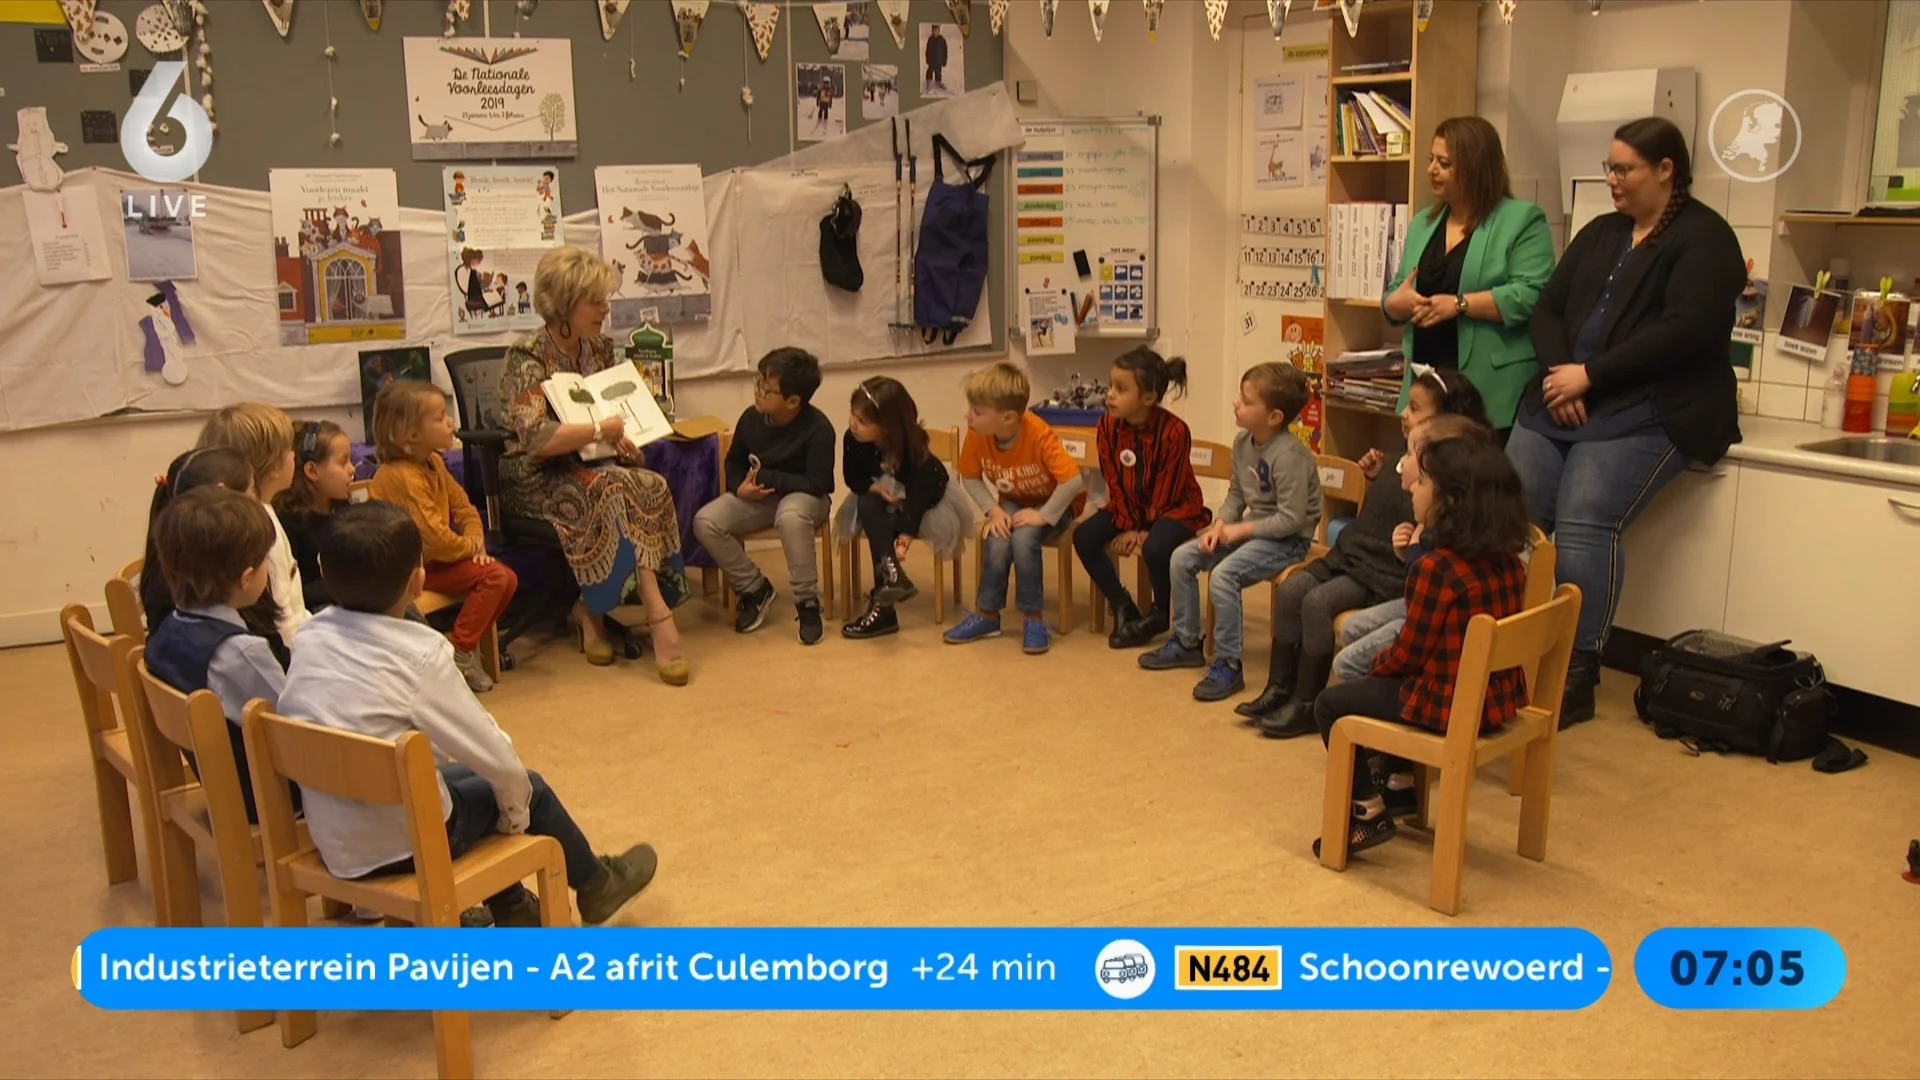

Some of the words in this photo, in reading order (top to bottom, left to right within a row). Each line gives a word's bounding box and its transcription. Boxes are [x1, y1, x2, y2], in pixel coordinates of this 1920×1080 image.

[453, 67, 468, 80] De
[472, 67, 530, 81] Nationale
[447, 82, 535, 100] Voorleesdagen
[481, 97, 505, 109] 2019
[300, 185, 341, 194] Voorlezen
[343, 185, 369, 193] maakt
[602, 186, 615, 194] Het
[617, 185, 649, 194] Nationale
[1246, 220, 1250, 230] 1
[1258, 220, 1263, 232] 2
[1271, 221, 1276, 232] 3
[1283, 222, 1289, 233] 4
[1297, 223, 1302, 235] 5
[1310, 222, 1316, 233] 6
[1030, 254, 1052, 262] zondag
[1244, 252, 1251, 262] 11
[1256, 252, 1264, 263] 12
[1268, 252, 1277, 263] 13
[1281, 252, 1290, 264] 14
[1294, 253, 1303, 264] 15
[1307, 252, 1316, 263] 16
[1244, 285, 1252, 296] 21
[1255, 285, 1265, 296] 22
[1268, 285, 1277, 297] 23
[1280, 286, 1290, 297] 24
[1294, 287, 1304, 298] 25
[1306, 286, 1317, 297] 26
[1243, 316, 1253, 329] 31
[1744, 332, 1760, 342] kring
[1784, 340, 1799, 350] boek
[1800, 346, 1818, 355] lezen
[1015, 463, 1040, 478] KIND
